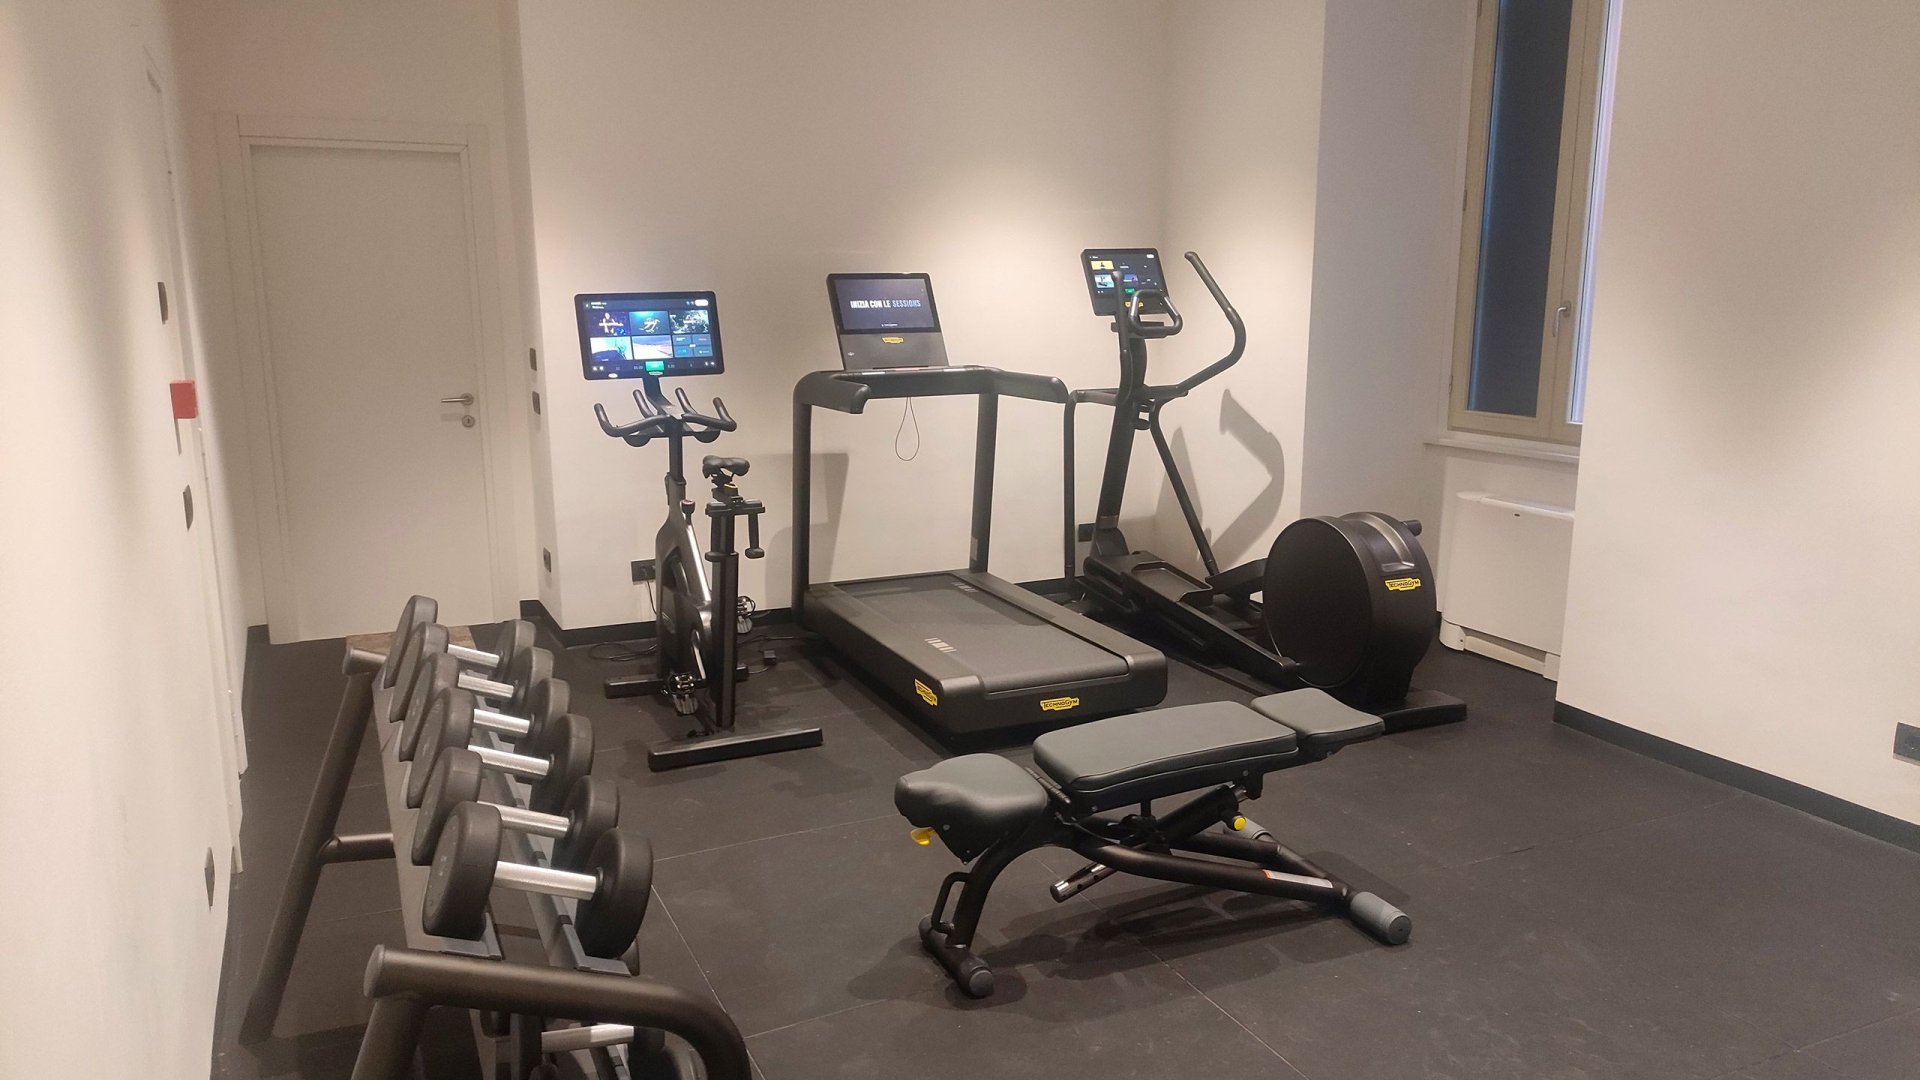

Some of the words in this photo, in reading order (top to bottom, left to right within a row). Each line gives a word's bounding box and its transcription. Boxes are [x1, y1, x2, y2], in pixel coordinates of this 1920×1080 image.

[850, 300, 870, 309] INIZIA
[870, 300, 882, 308] CON
[883, 300, 891, 308] LE
[892, 299, 921, 308] SESSIONS
[1386, 579, 1420, 589] TECHNOGYM
[1041, 698, 1079, 709] TECHNOGYM
